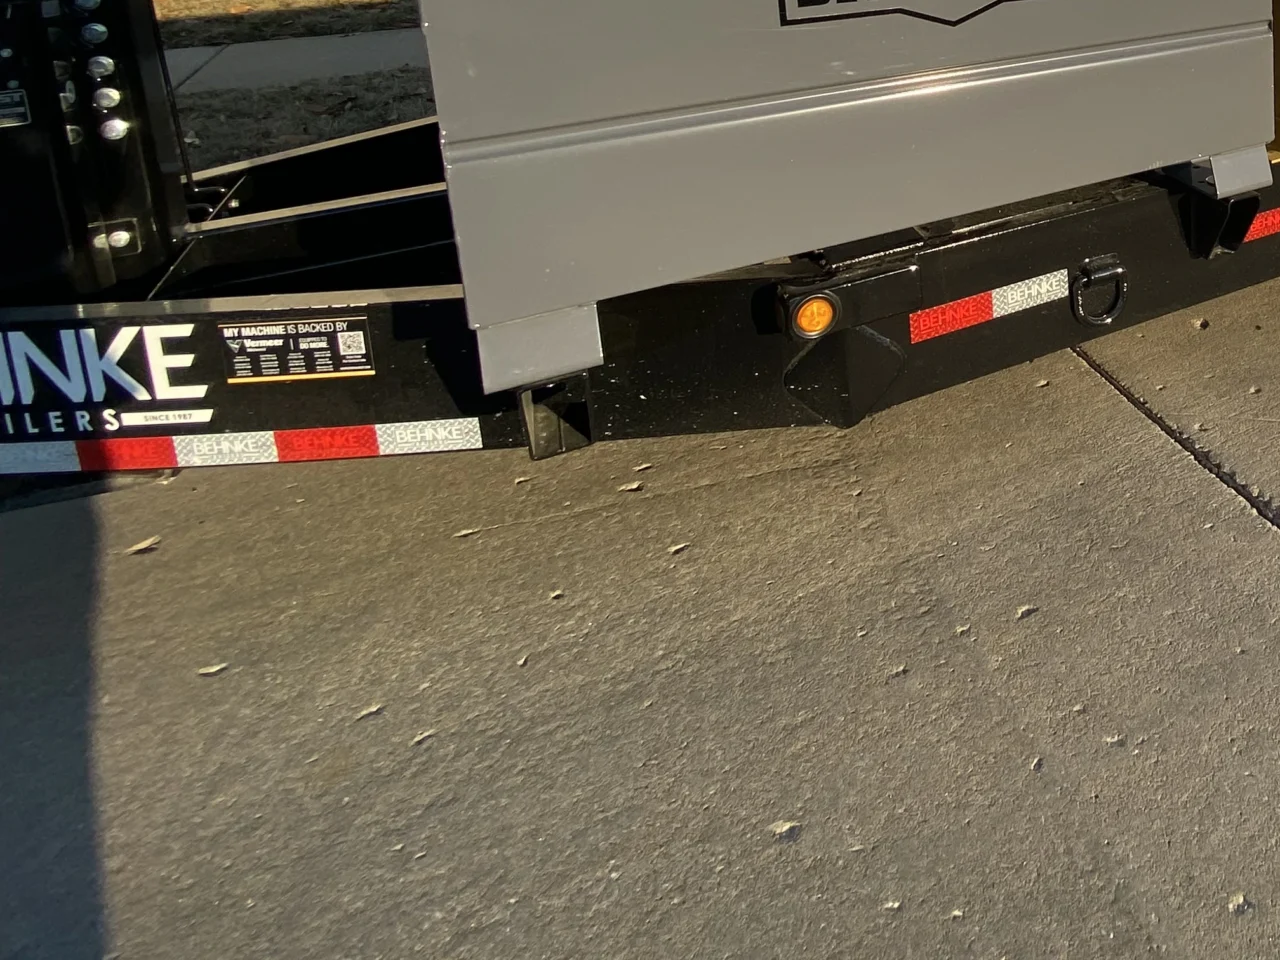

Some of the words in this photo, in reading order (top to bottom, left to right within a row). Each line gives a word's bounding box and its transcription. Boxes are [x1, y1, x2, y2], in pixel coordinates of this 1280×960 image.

[1007, 278, 1062, 304] BEHNKE
[919, 302, 978, 330] BEHNKE
[223, 328, 239, 338] MY
[241, 325, 286, 337] MACHINE
[287, 325, 296, 334] IS
[298, 322, 333, 333] BACKED
[335, 321, 348, 331] BY
[243, 339, 284, 348] Vermeer
[144, 414, 170, 422] SINCE
[172, 413, 193, 421] 1987
[395, 426, 463, 443] BEHNKE
[193, 440, 260, 455] BEHNKE
